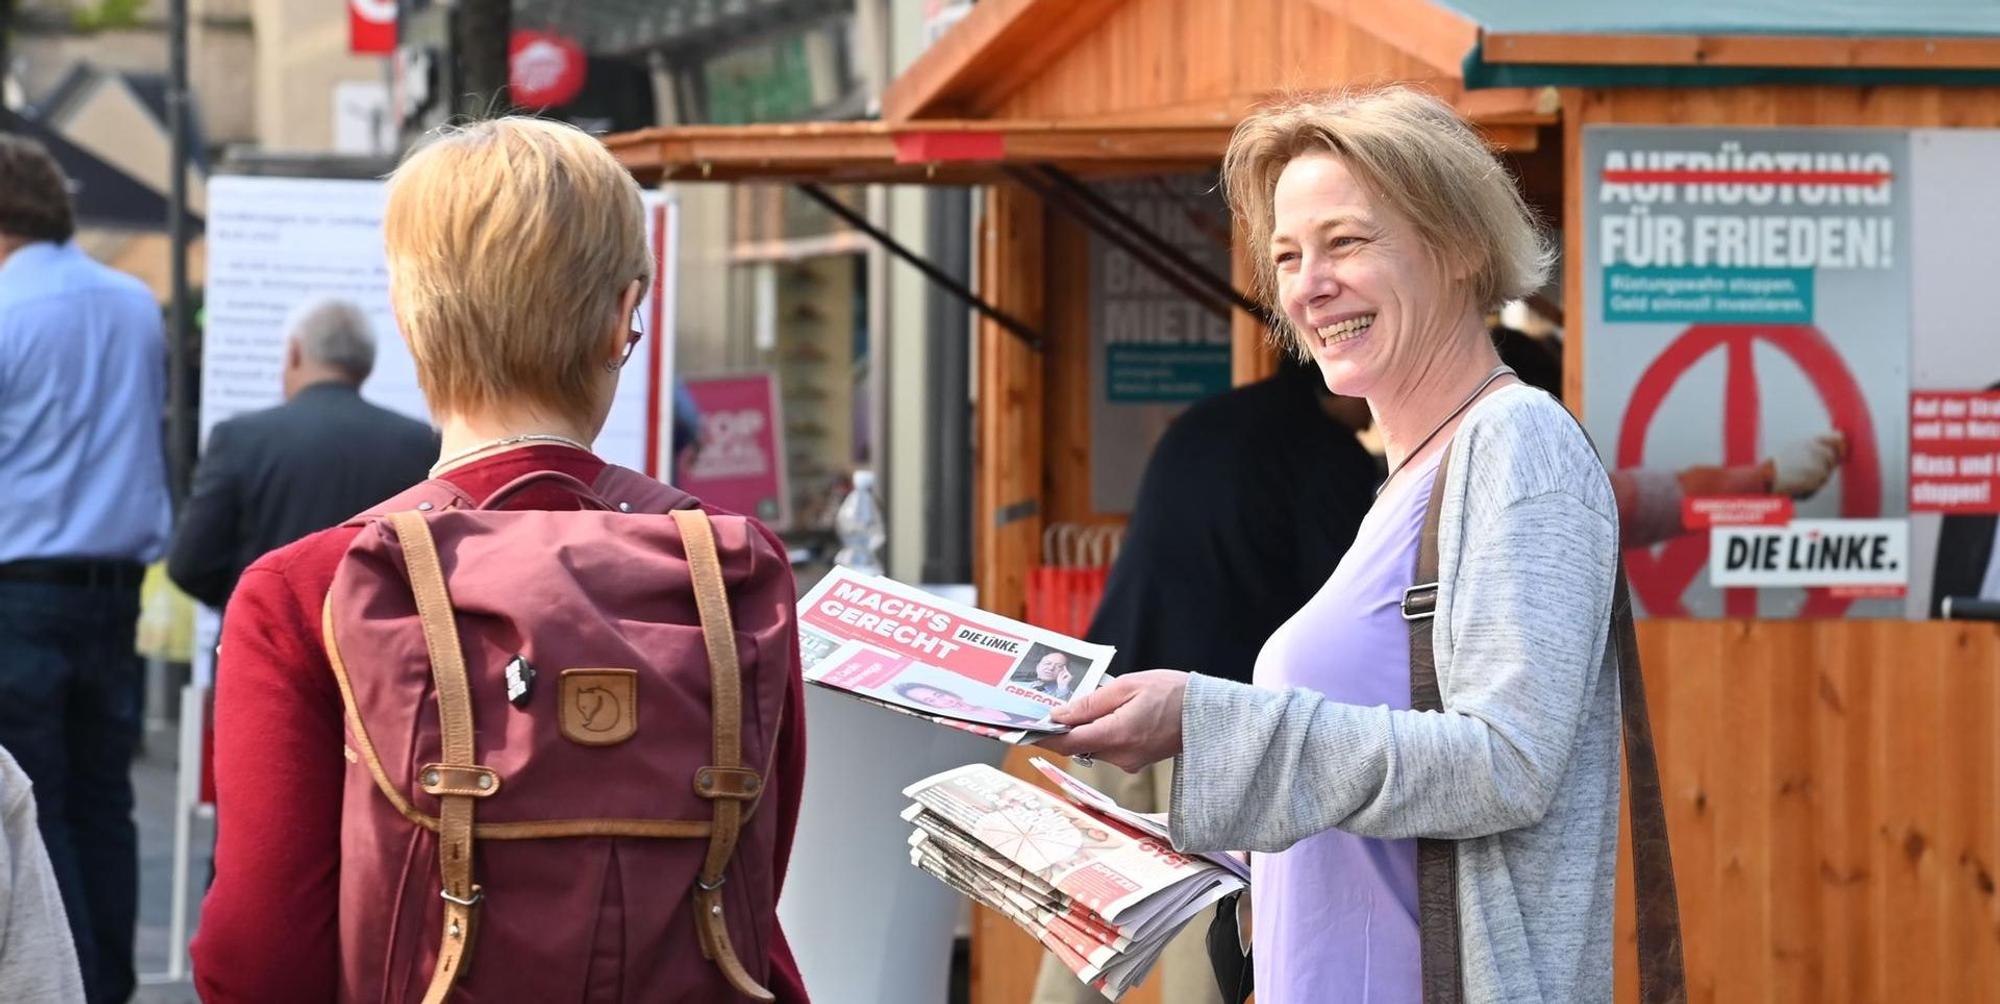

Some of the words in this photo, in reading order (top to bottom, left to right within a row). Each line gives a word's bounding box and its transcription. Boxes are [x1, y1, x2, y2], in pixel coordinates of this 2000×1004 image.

[1600, 142, 1891, 204] AUFRÜSTUNG
[1600, 205, 1684, 267] FÜR
[1693, 216, 1893, 268] FRIEDEN!
[1960, 453, 1993, 476] und
[1726, 535, 1781, 570] DIE
[820, 600, 960, 659] GERECHT
[833, 582, 951, 632] MACH'S
[958, 629, 982, 642] DIE
